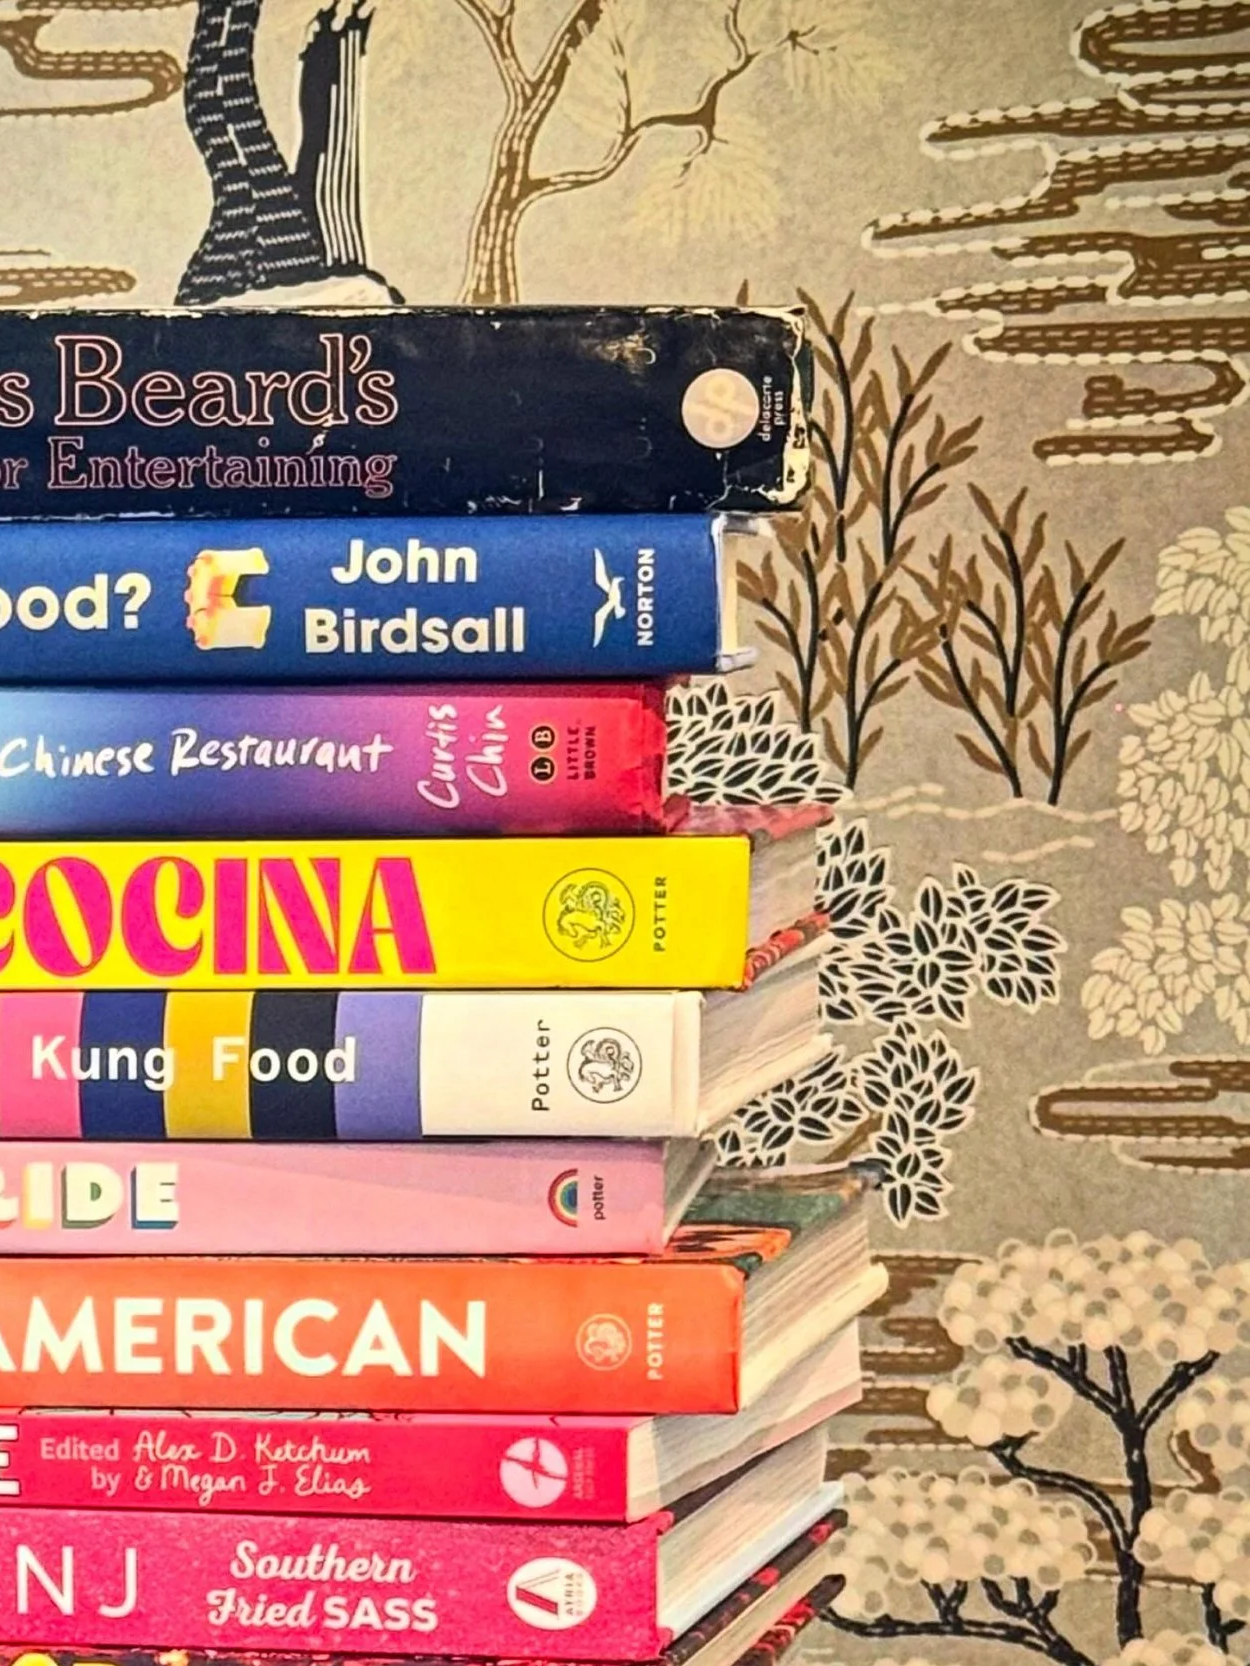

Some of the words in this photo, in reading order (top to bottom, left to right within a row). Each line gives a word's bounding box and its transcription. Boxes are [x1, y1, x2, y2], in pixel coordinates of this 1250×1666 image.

[53, 333, 399, 427] Beard's
[758, 376, 772, 442] delacorte
[773, 391, 784, 427] press
[47, 435, 398, 498] Entertaining
[331, 539, 478, 584] John
[636, 547, 655, 647] NORTON
[305, 608, 524, 654] Birdsall
[170, 727, 394, 777] Restaurant
[417, 704, 460, 809] Curtis
[465, 704, 509, 796] Chin
[584, 726, 596, 780] BROWN
[654, 876, 667, 951] POTTER
[31, 1036, 175, 1091] Kung
[211, 1036, 357, 1082] Food
[531, 1019, 552, 1111] Potter
[592, 1174, 605, 1221] potter
[647, 1302, 663, 1380] POTTER
[40, 1437, 120, 1461] Edited
[132, 1430, 202, 1463] Alex
[254, 1432, 371, 1464] Ketchum
[90, 1465, 121, 1497] by
[134, 1468, 153, 1492] &
[160, 1465, 247, 1507] Megan
[294, 1464, 372, 1500] Elias
[230, 1540, 419, 1583] Southern
[206, 1587, 317, 1627] Fried
[323, 1596, 438, 1632] SASS
